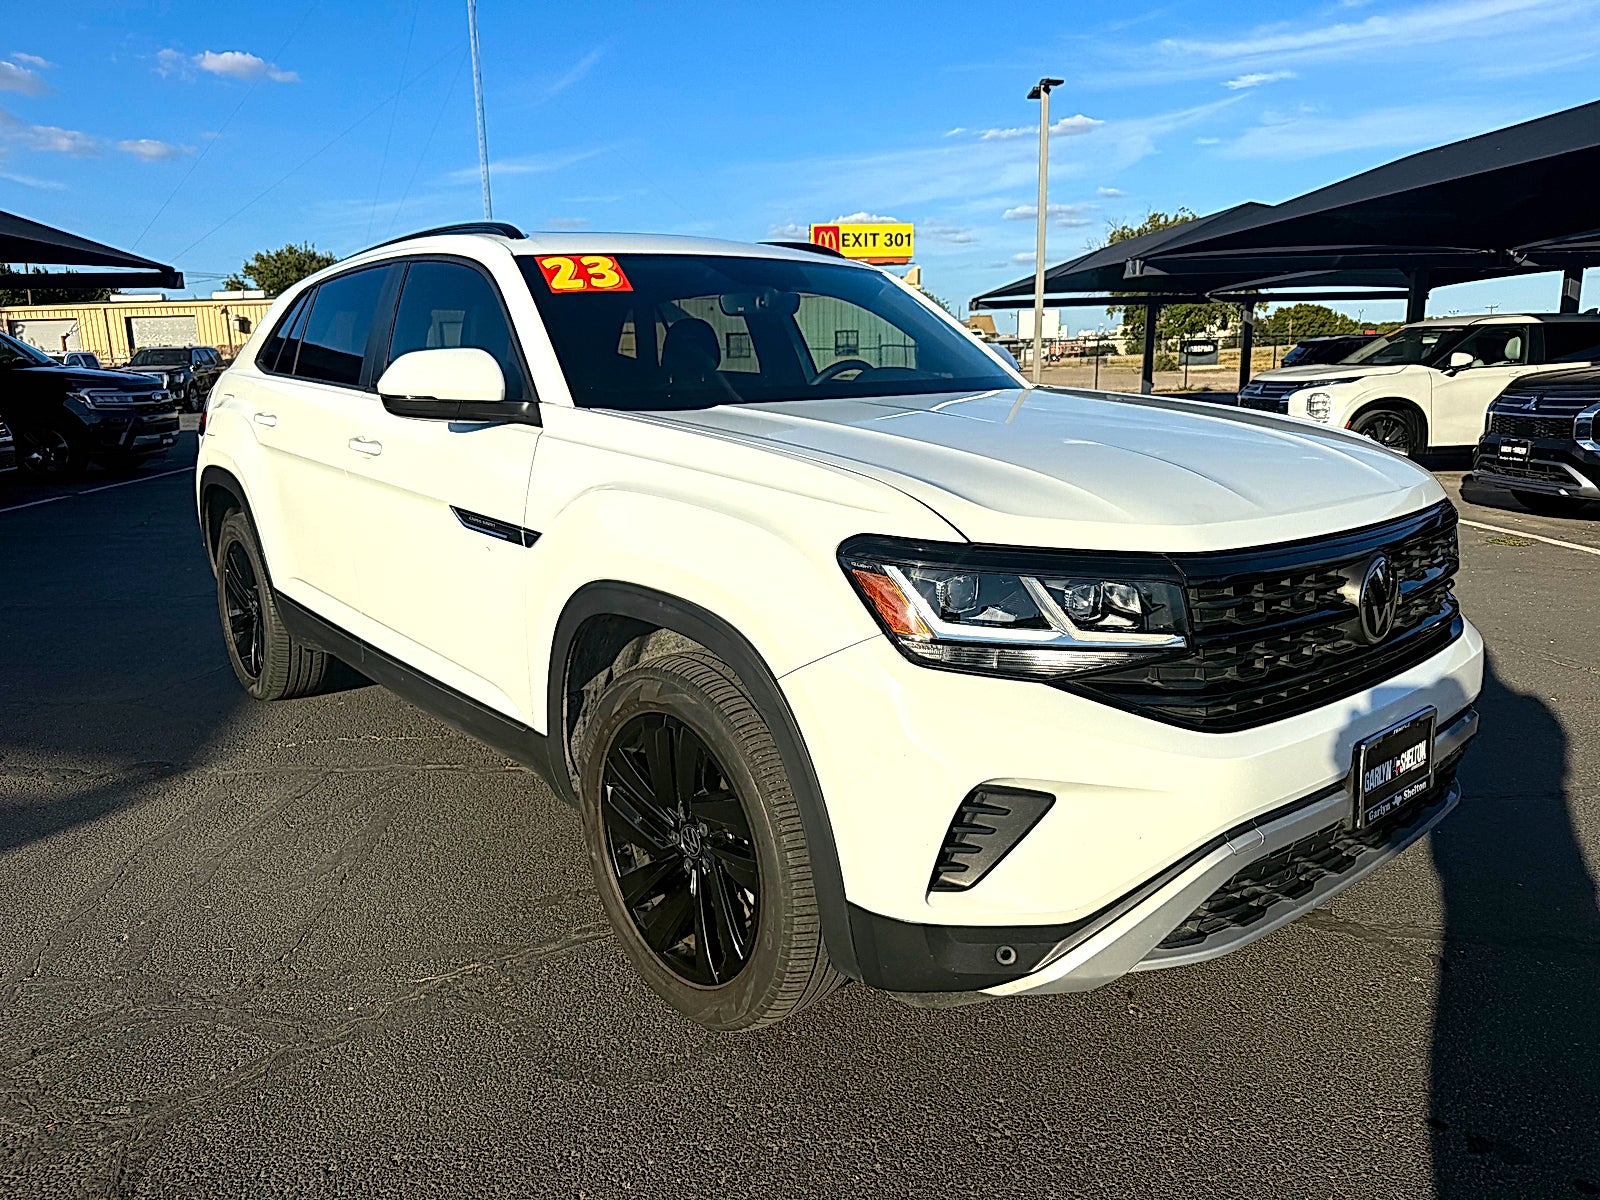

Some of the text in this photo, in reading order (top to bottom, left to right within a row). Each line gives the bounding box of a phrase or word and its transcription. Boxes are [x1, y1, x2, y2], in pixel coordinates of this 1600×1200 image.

[841, 232, 912, 248] EXIT 301
[541, 255, 624, 291] 23
[1364, 739, 1427, 793] GARLYN SHELTON
[1368, 780, 1427, 821] Garlyn Shelton
